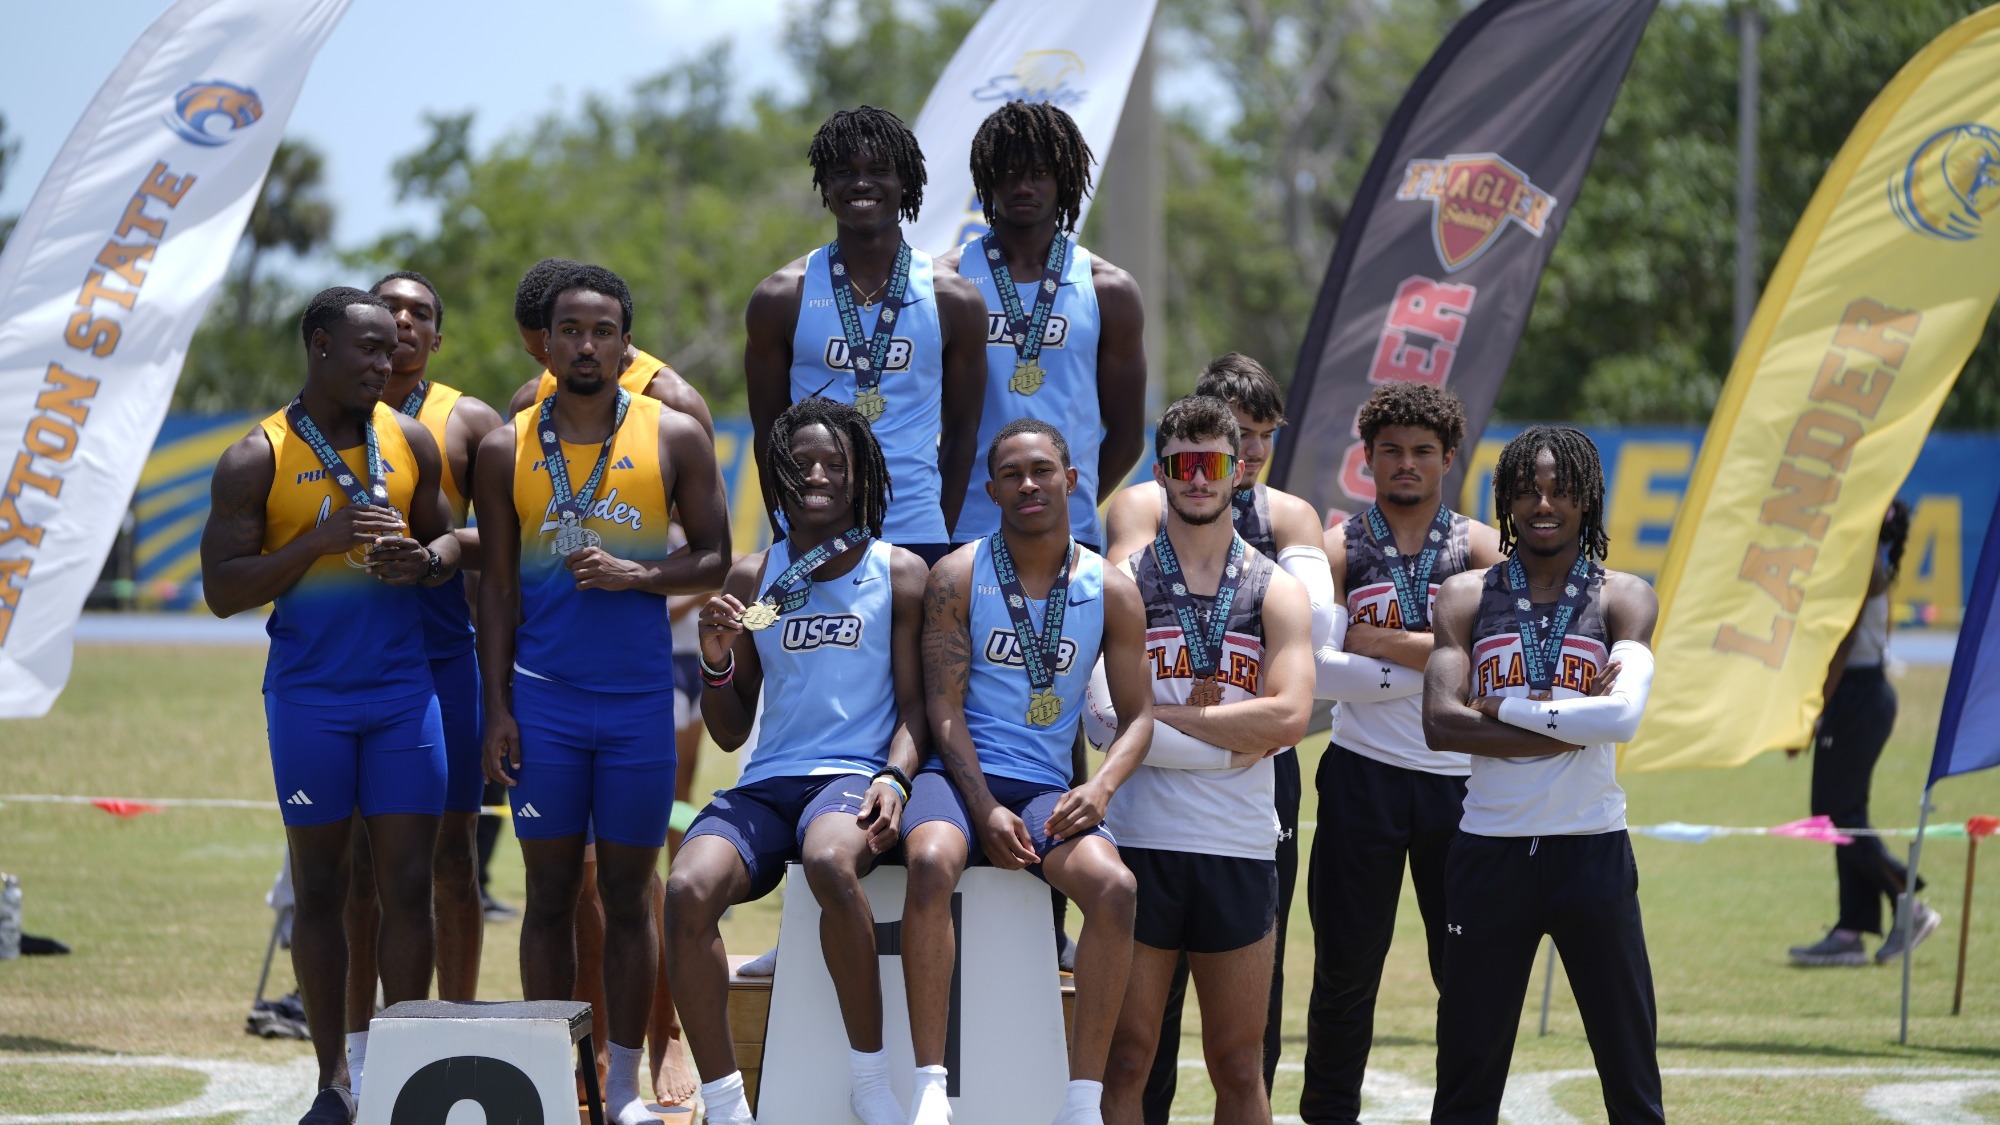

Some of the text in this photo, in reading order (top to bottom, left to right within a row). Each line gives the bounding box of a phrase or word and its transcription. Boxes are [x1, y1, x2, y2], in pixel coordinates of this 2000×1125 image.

[1403, 162, 1552, 229] FLAGLER
[999, 265, 1016, 297] PEACH
[0, 160, 197, 647] AYTON STATE
[1008, 370, 1047, 392] PBC
[296, 420, 334, 470] Conference
[302, 414, 342, 466] PEACH BELT
[1713, 296, 1921, 670] LANDER
[776, 559, 806, 588] PEACH
[804, 544, 827, 564] BELT
[1418, 548, 1438, 605] PEACH BELT
[1177, 608, 1193, 633] BELT
[1211, 587, 1235, 648] PEACH BELT
[1390, 566, 1415, 625] PEACH BELT
[784, 617, 858, 648] USCB
[1048, 588, 1066, 654] PEACH BELT
[1519, 621, 1533, 646] BELT
[1547, 605, 1574, 664] PEACH BELT
[1024, 647, 1042, 685] PEACH
[1186, 633, 1204, 670] PEACH
[1525, 647, 1540, 683] PEACH
[1529, 620, 1546, 681] Conference
[1025, 698, 1065, 726] PBC
